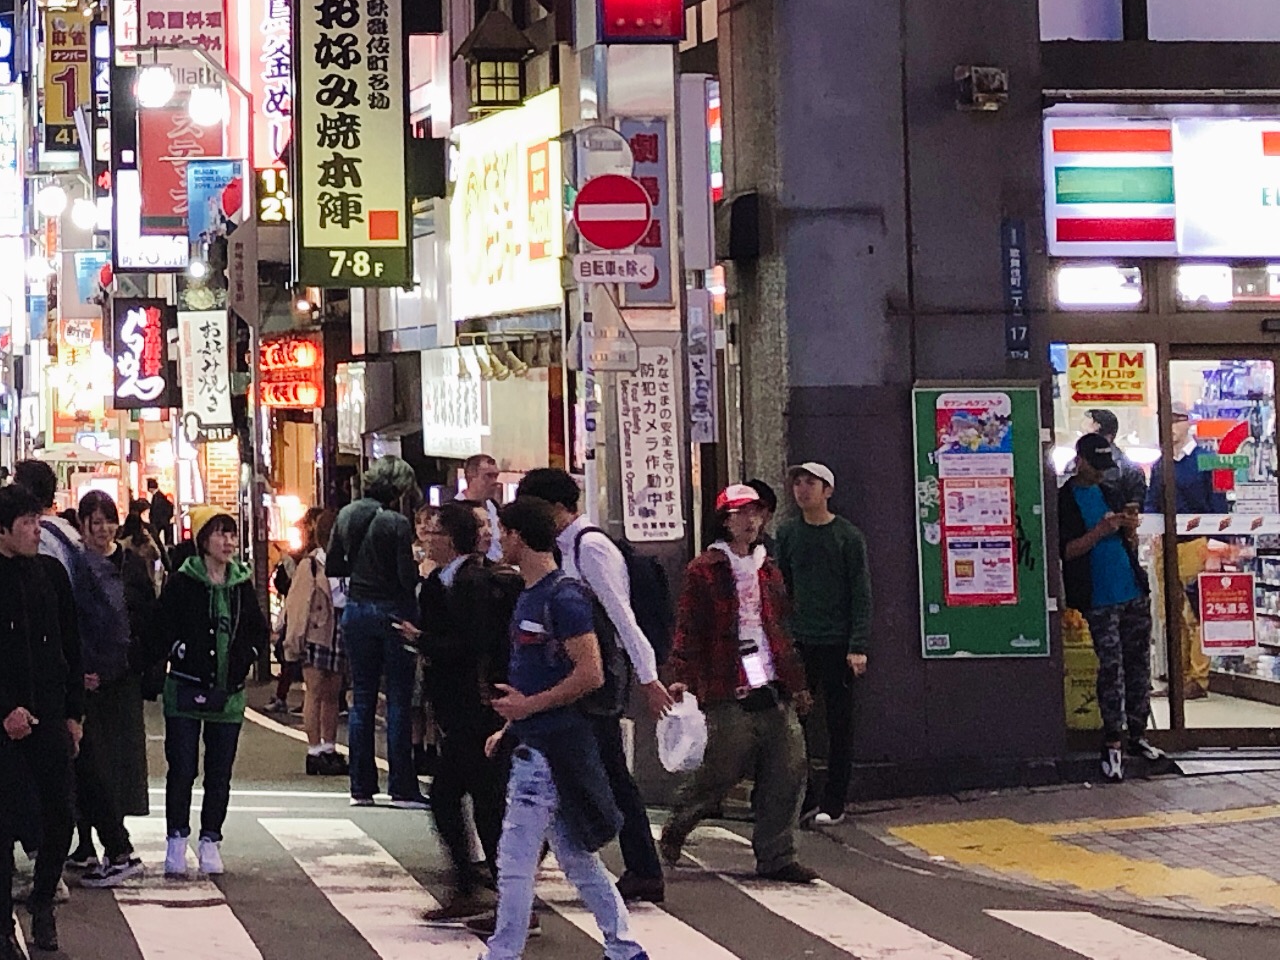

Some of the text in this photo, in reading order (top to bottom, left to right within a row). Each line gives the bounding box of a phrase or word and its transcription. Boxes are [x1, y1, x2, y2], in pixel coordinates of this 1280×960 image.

[53, 51, 86, 61] ナンバー
[53, 66, 78, 119] 1
[580, 260, 648, 277] 自転車を除く
[1010, 326, 1027, 341] 17
[1070, 352, 1144, 368] ATM
[640, 363, 662, 508] 防犯カメラ作動中
[656, 354, 675, 516] みなさまの安全を守ります
[643, 529, 669, 538] Police
